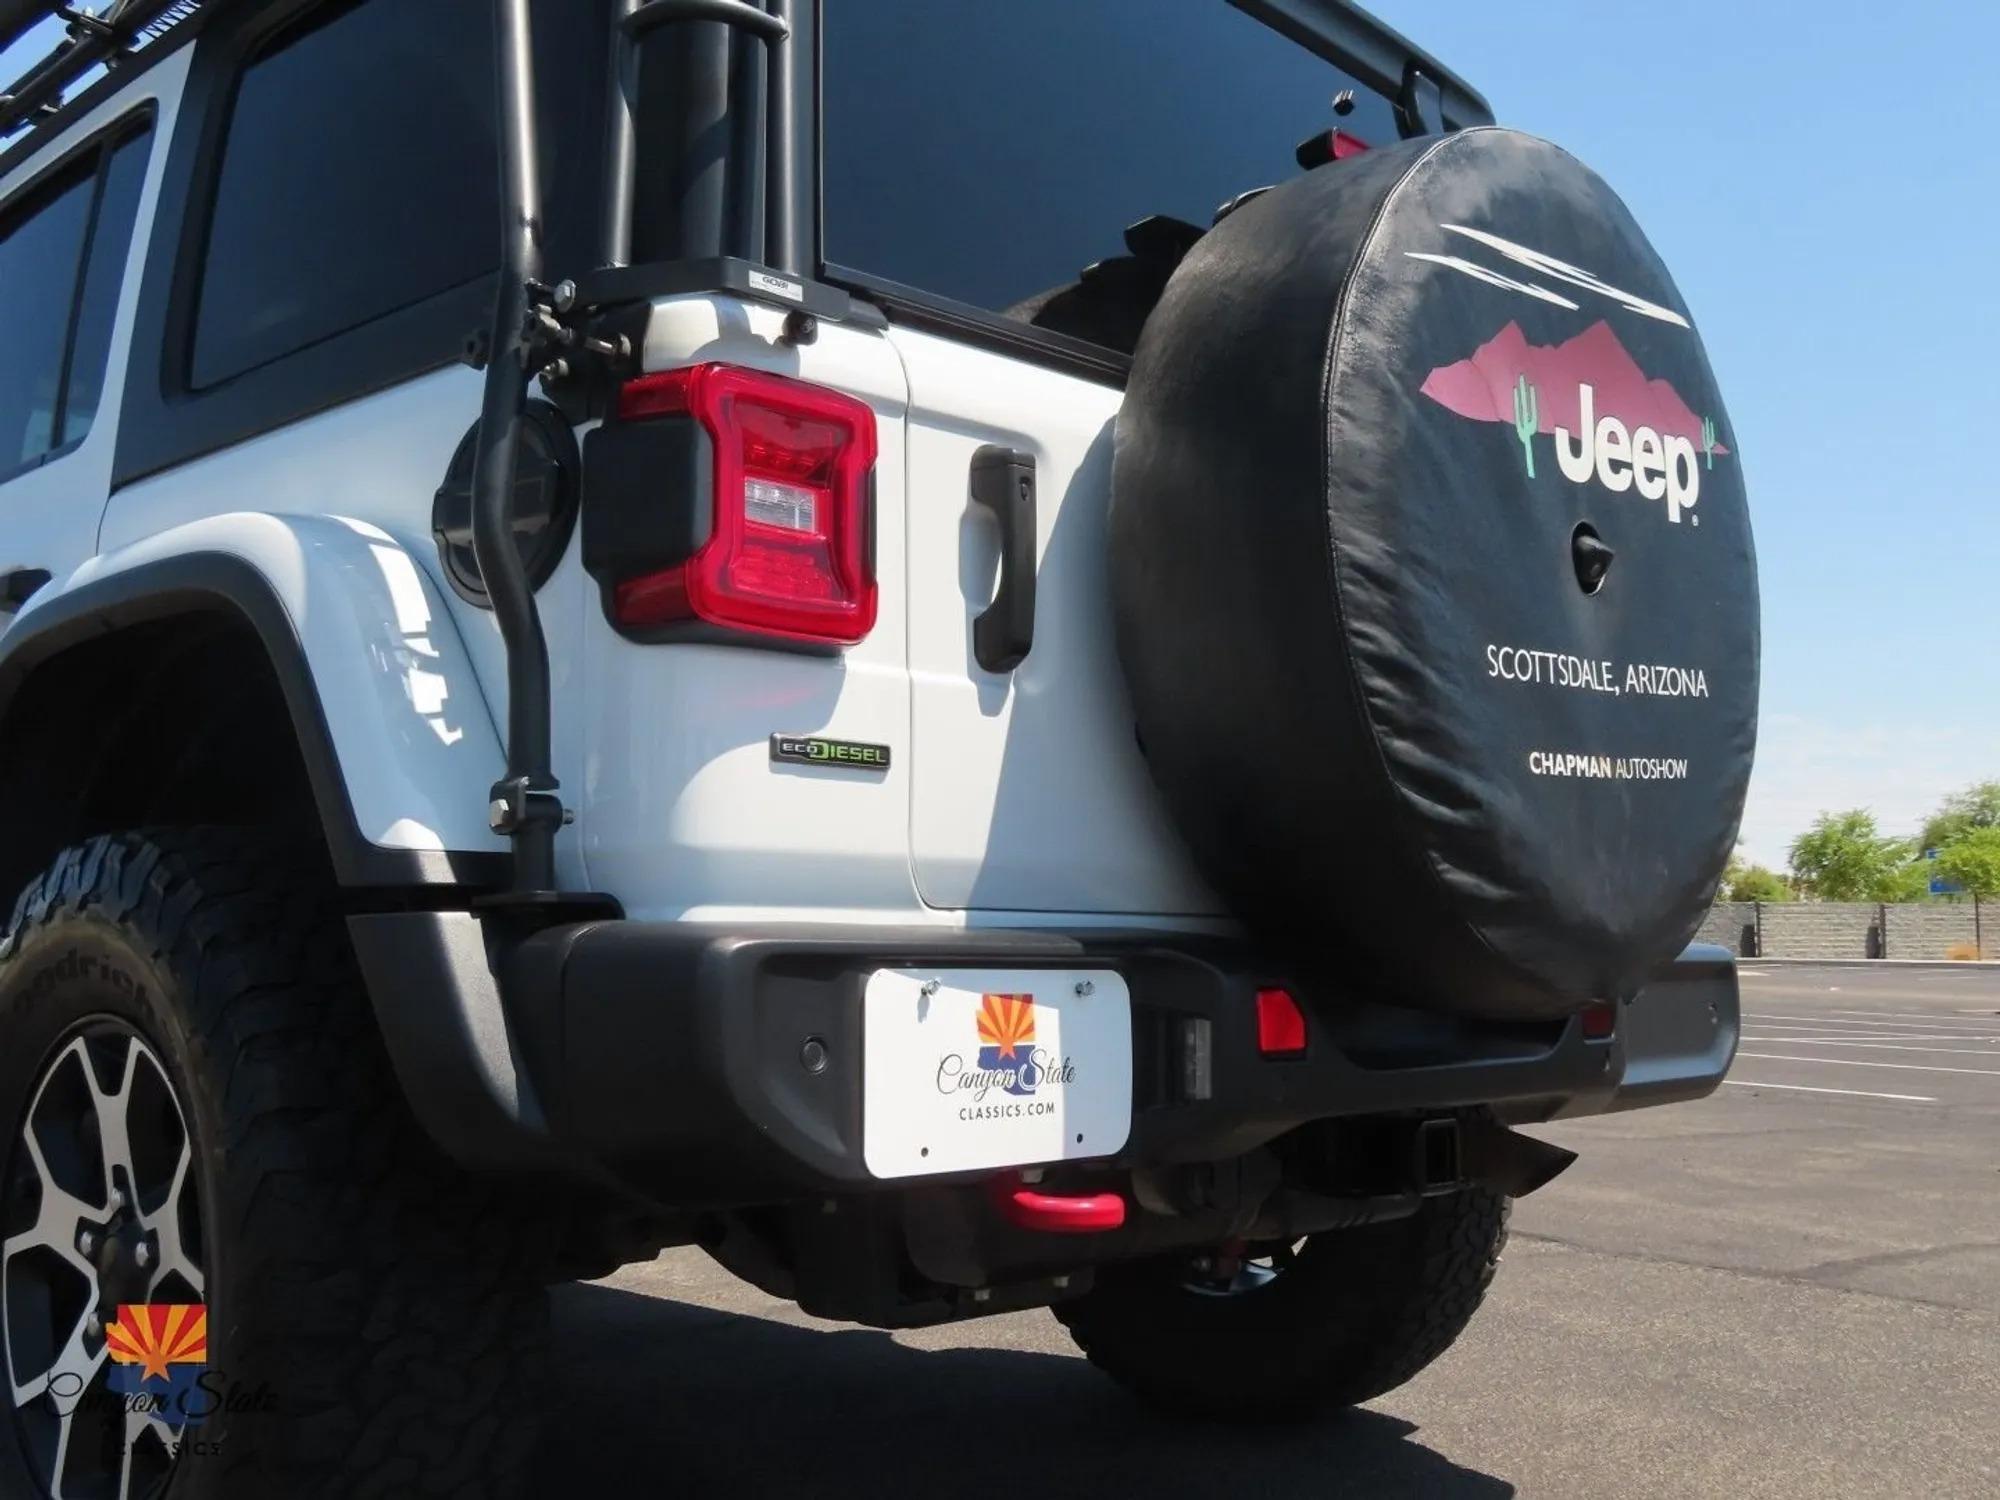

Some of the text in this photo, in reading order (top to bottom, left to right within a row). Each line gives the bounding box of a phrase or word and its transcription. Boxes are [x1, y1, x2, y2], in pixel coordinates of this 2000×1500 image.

[1555, 383, 1699, 524] Jeep
[1487, 644, 1709, 698] SCOTTSDALE, ARIZONA
[1529, 752, 1688, 779] CHAPMAN AUTOSHOW
[936, 1048, 1077, 1102] Canyon State
[959, 1102, 1055, 1121] CLASSICS.COM
